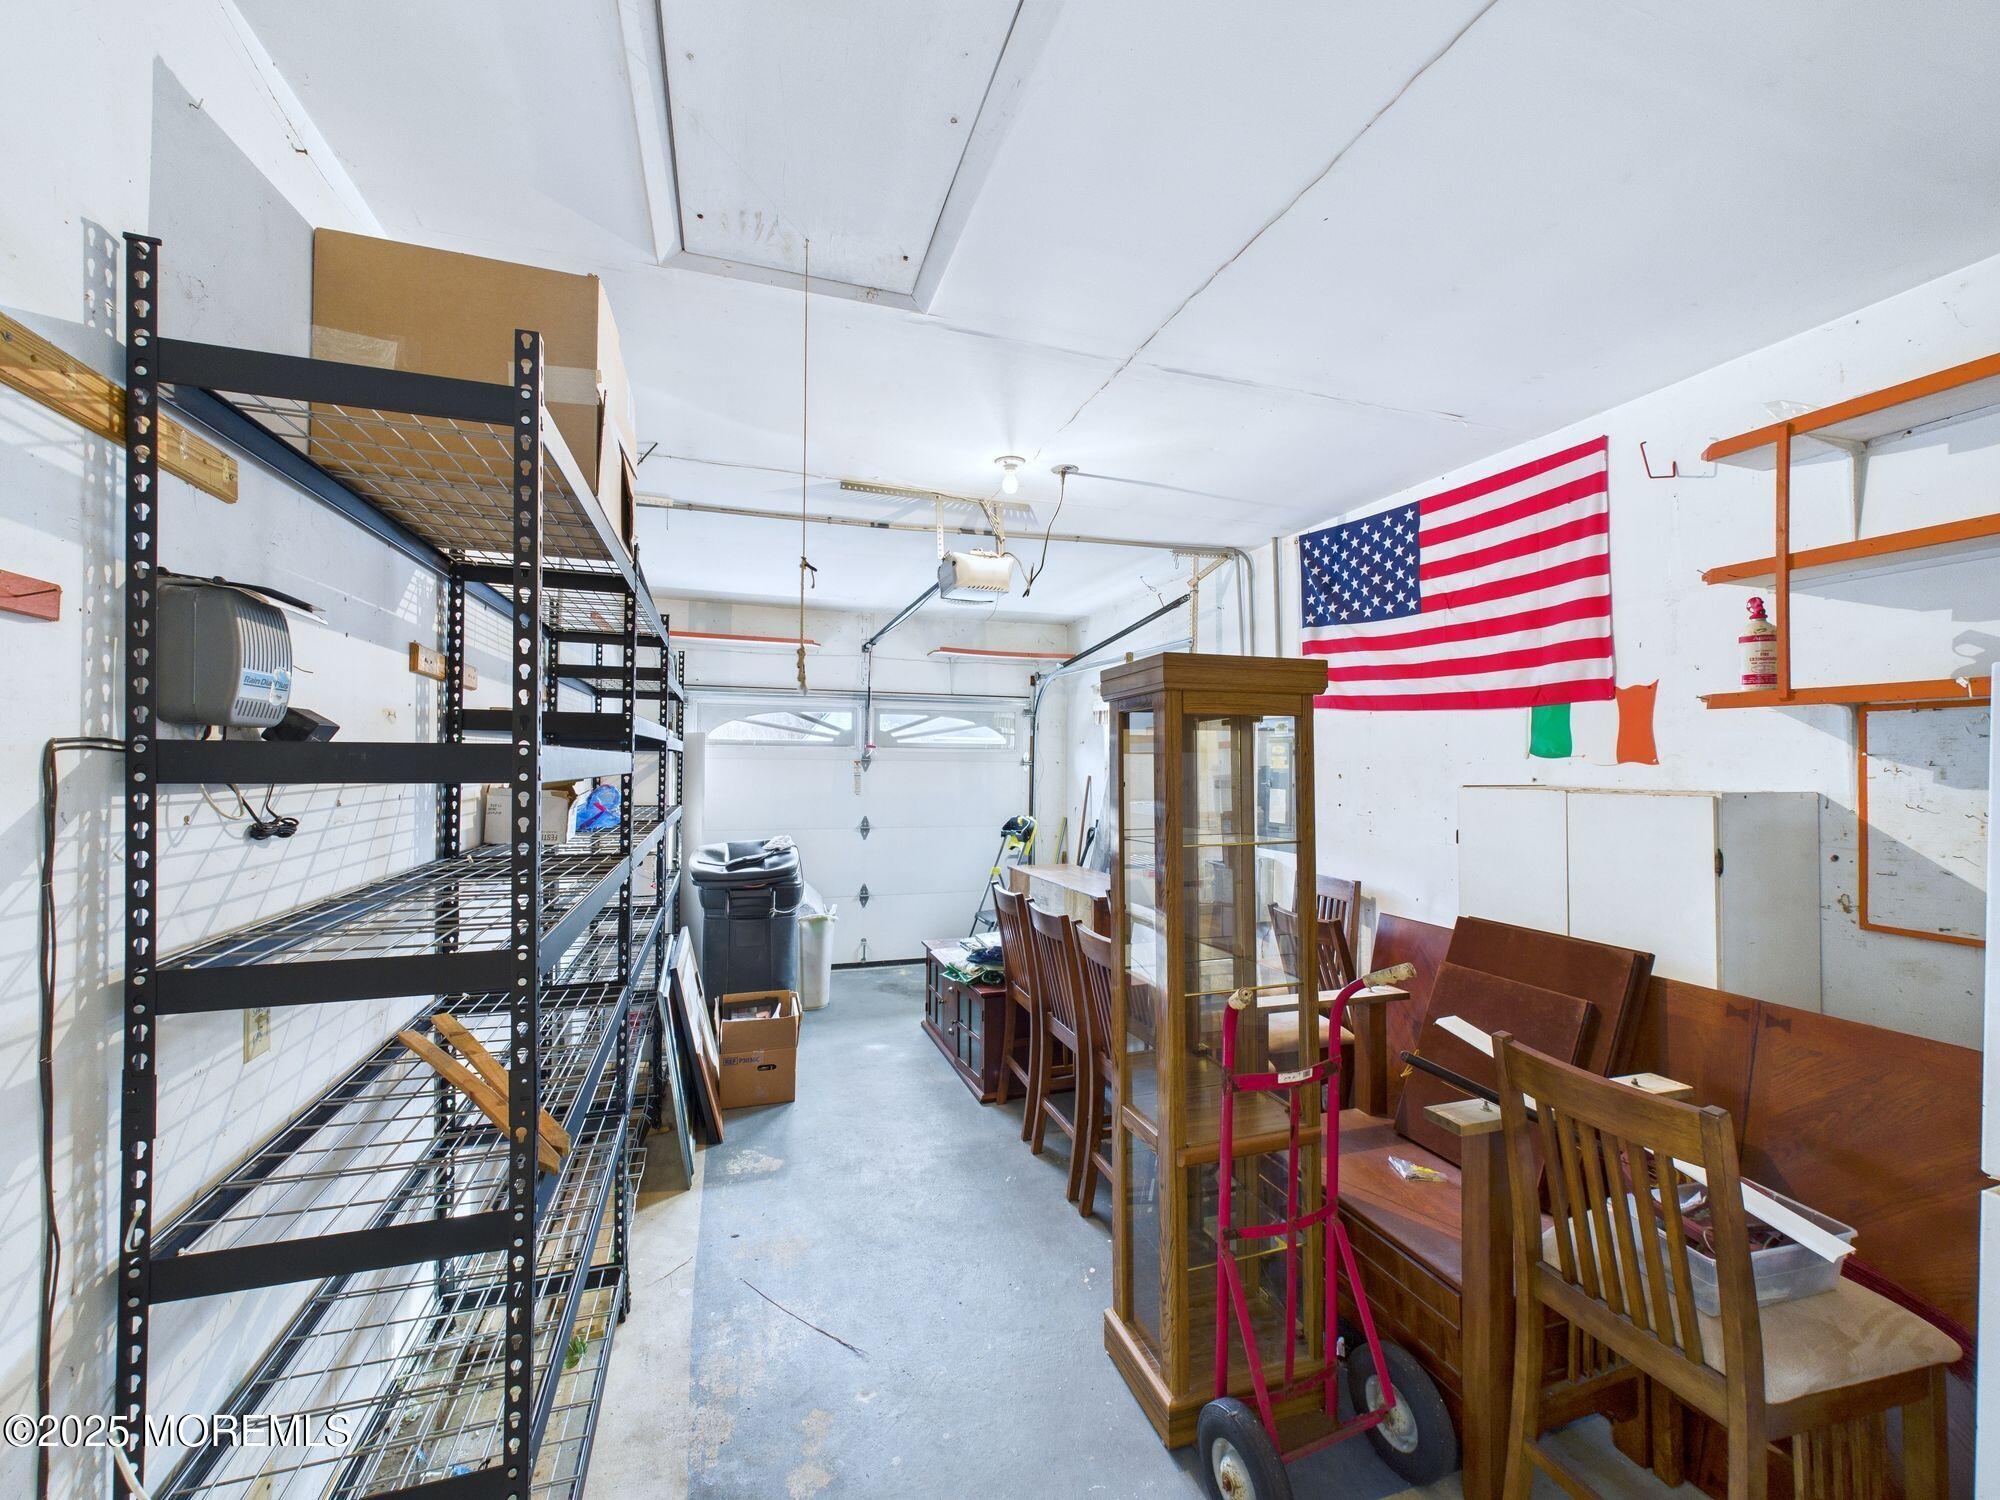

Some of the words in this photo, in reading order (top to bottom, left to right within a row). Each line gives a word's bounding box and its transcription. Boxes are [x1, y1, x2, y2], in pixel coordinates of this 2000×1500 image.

[244, 675, 260, 684] Rain
[260, 678, 275, 687] Dia
[275, 680, 289, 690] Plus
